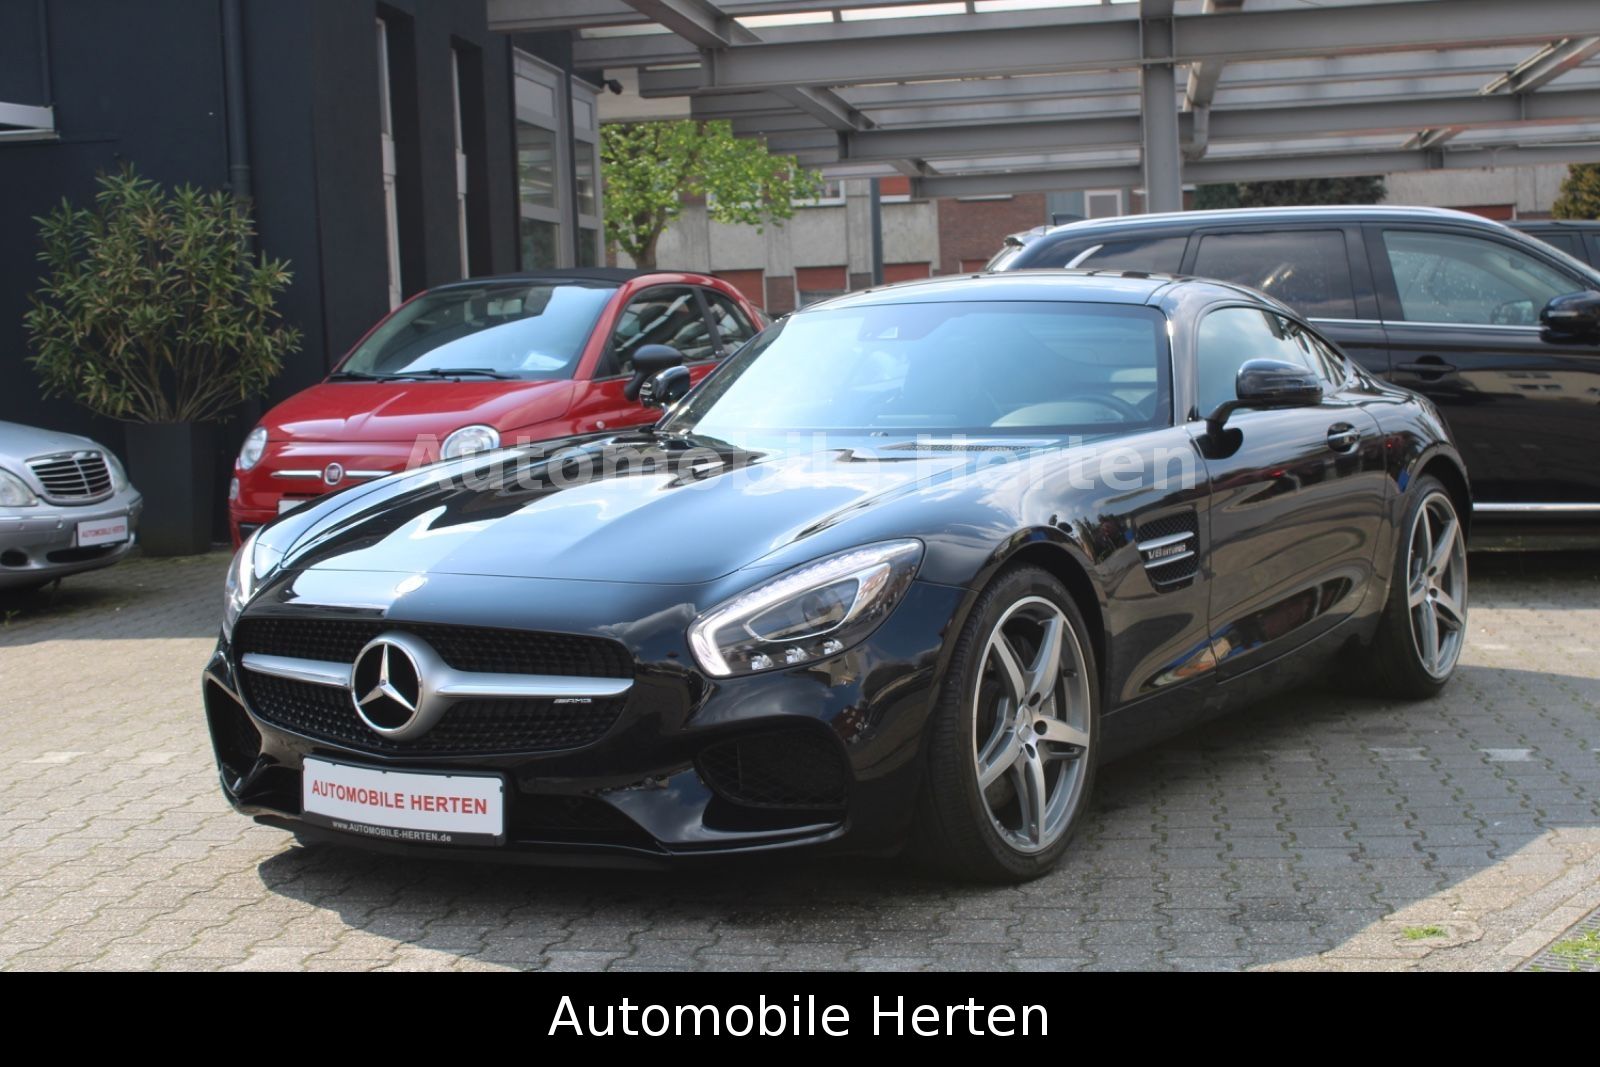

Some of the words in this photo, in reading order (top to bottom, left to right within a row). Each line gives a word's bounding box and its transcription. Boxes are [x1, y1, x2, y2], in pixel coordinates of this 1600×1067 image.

[1148, 548, 1162, 560] V8
[311, 779, 405, 810] AUTOMOBILE
[410, 794, 488, 815] HERTEN
[332, 820, 452, 842] www.AUTOMOBILE-HERTEN.de
